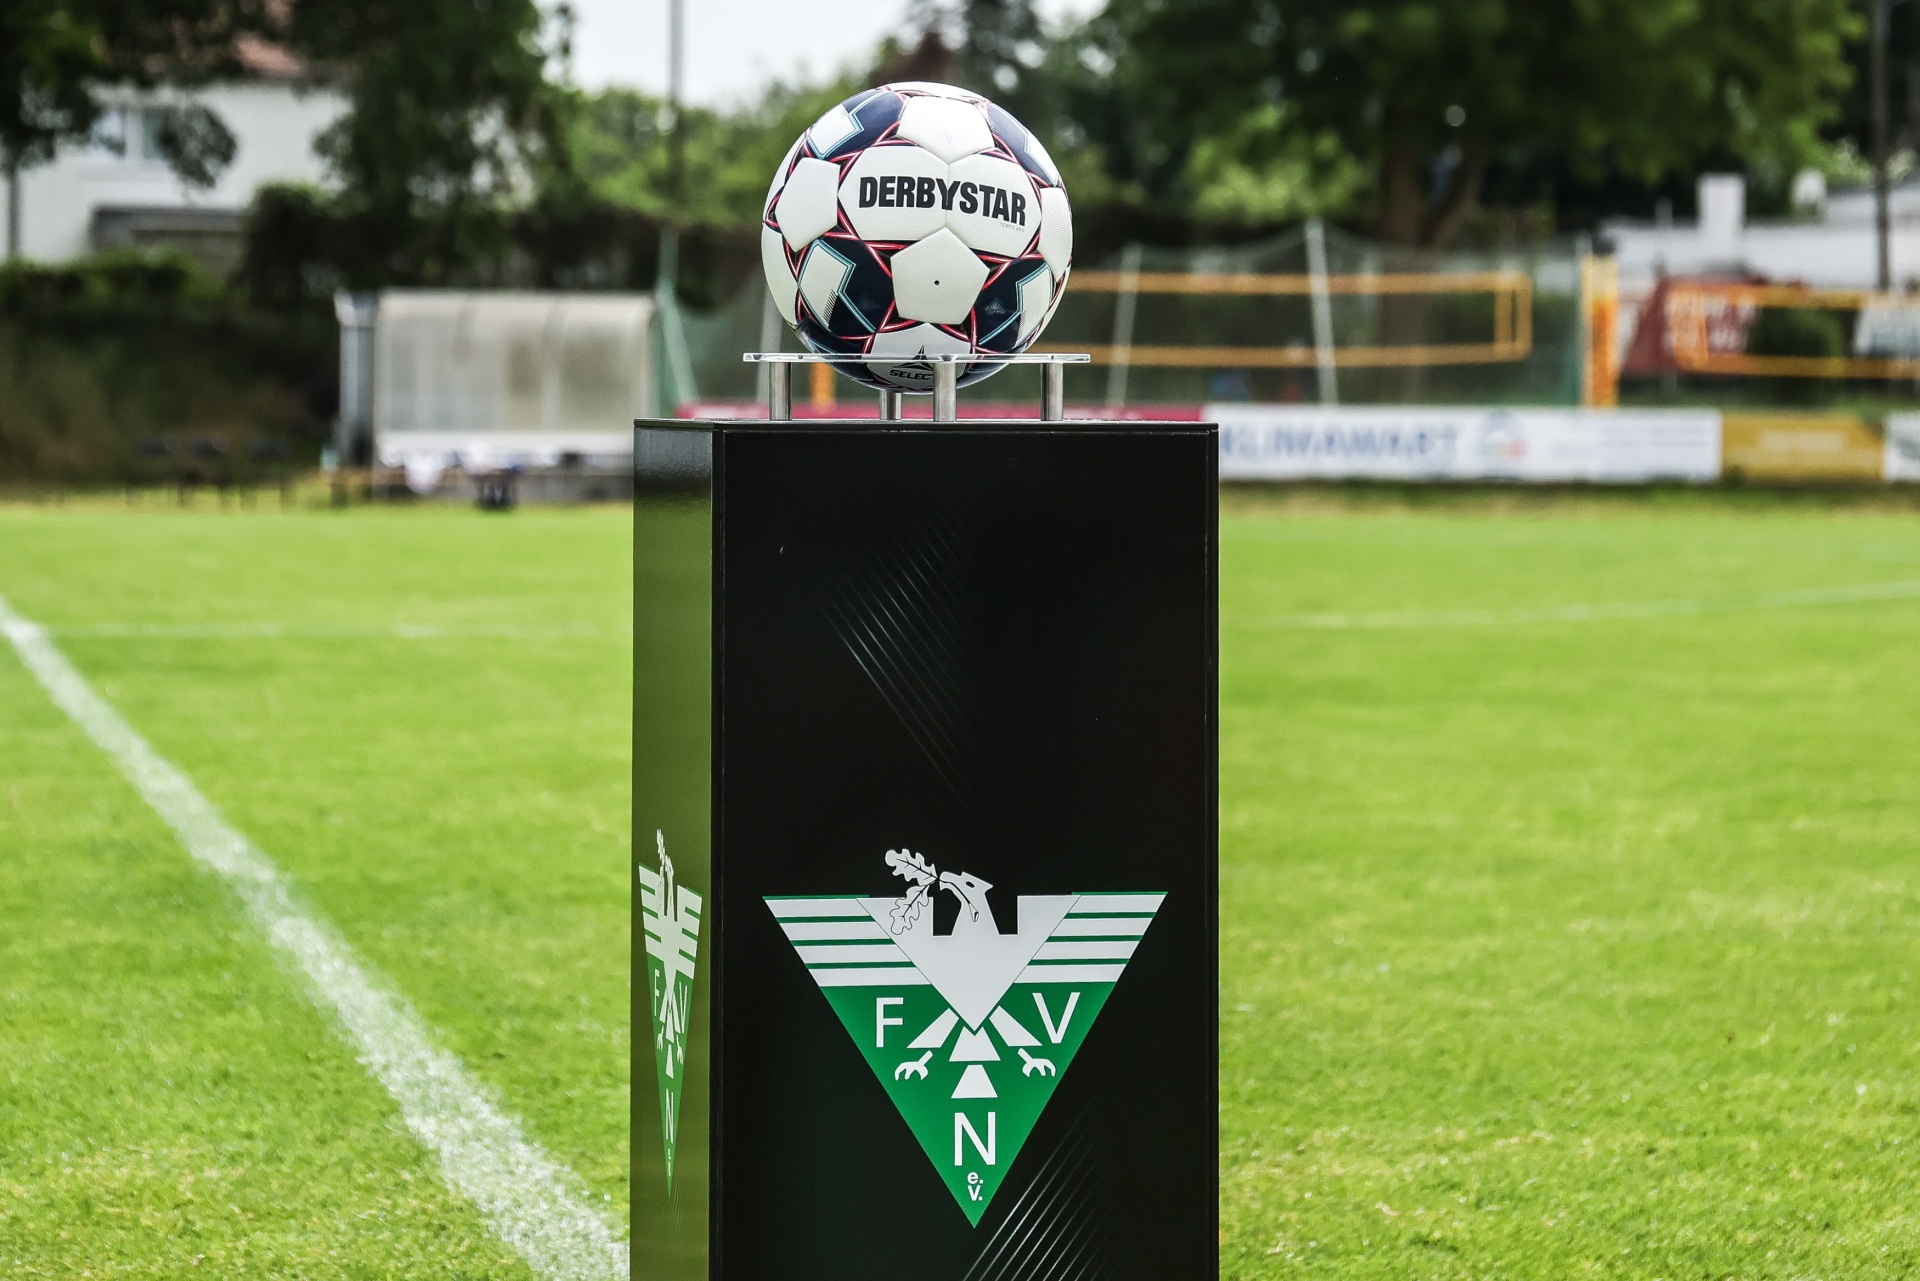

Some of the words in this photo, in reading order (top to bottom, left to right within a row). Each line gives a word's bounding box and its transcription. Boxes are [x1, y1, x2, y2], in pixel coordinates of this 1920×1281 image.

[859, 176, 1026, 226] DERBYSTAR
[889, 369, 934, 380] SELEC
[875, 997, 904, 1048] F
[1032, 992, 1081, 1044] V
[954, 1111, 996, 1167] N
